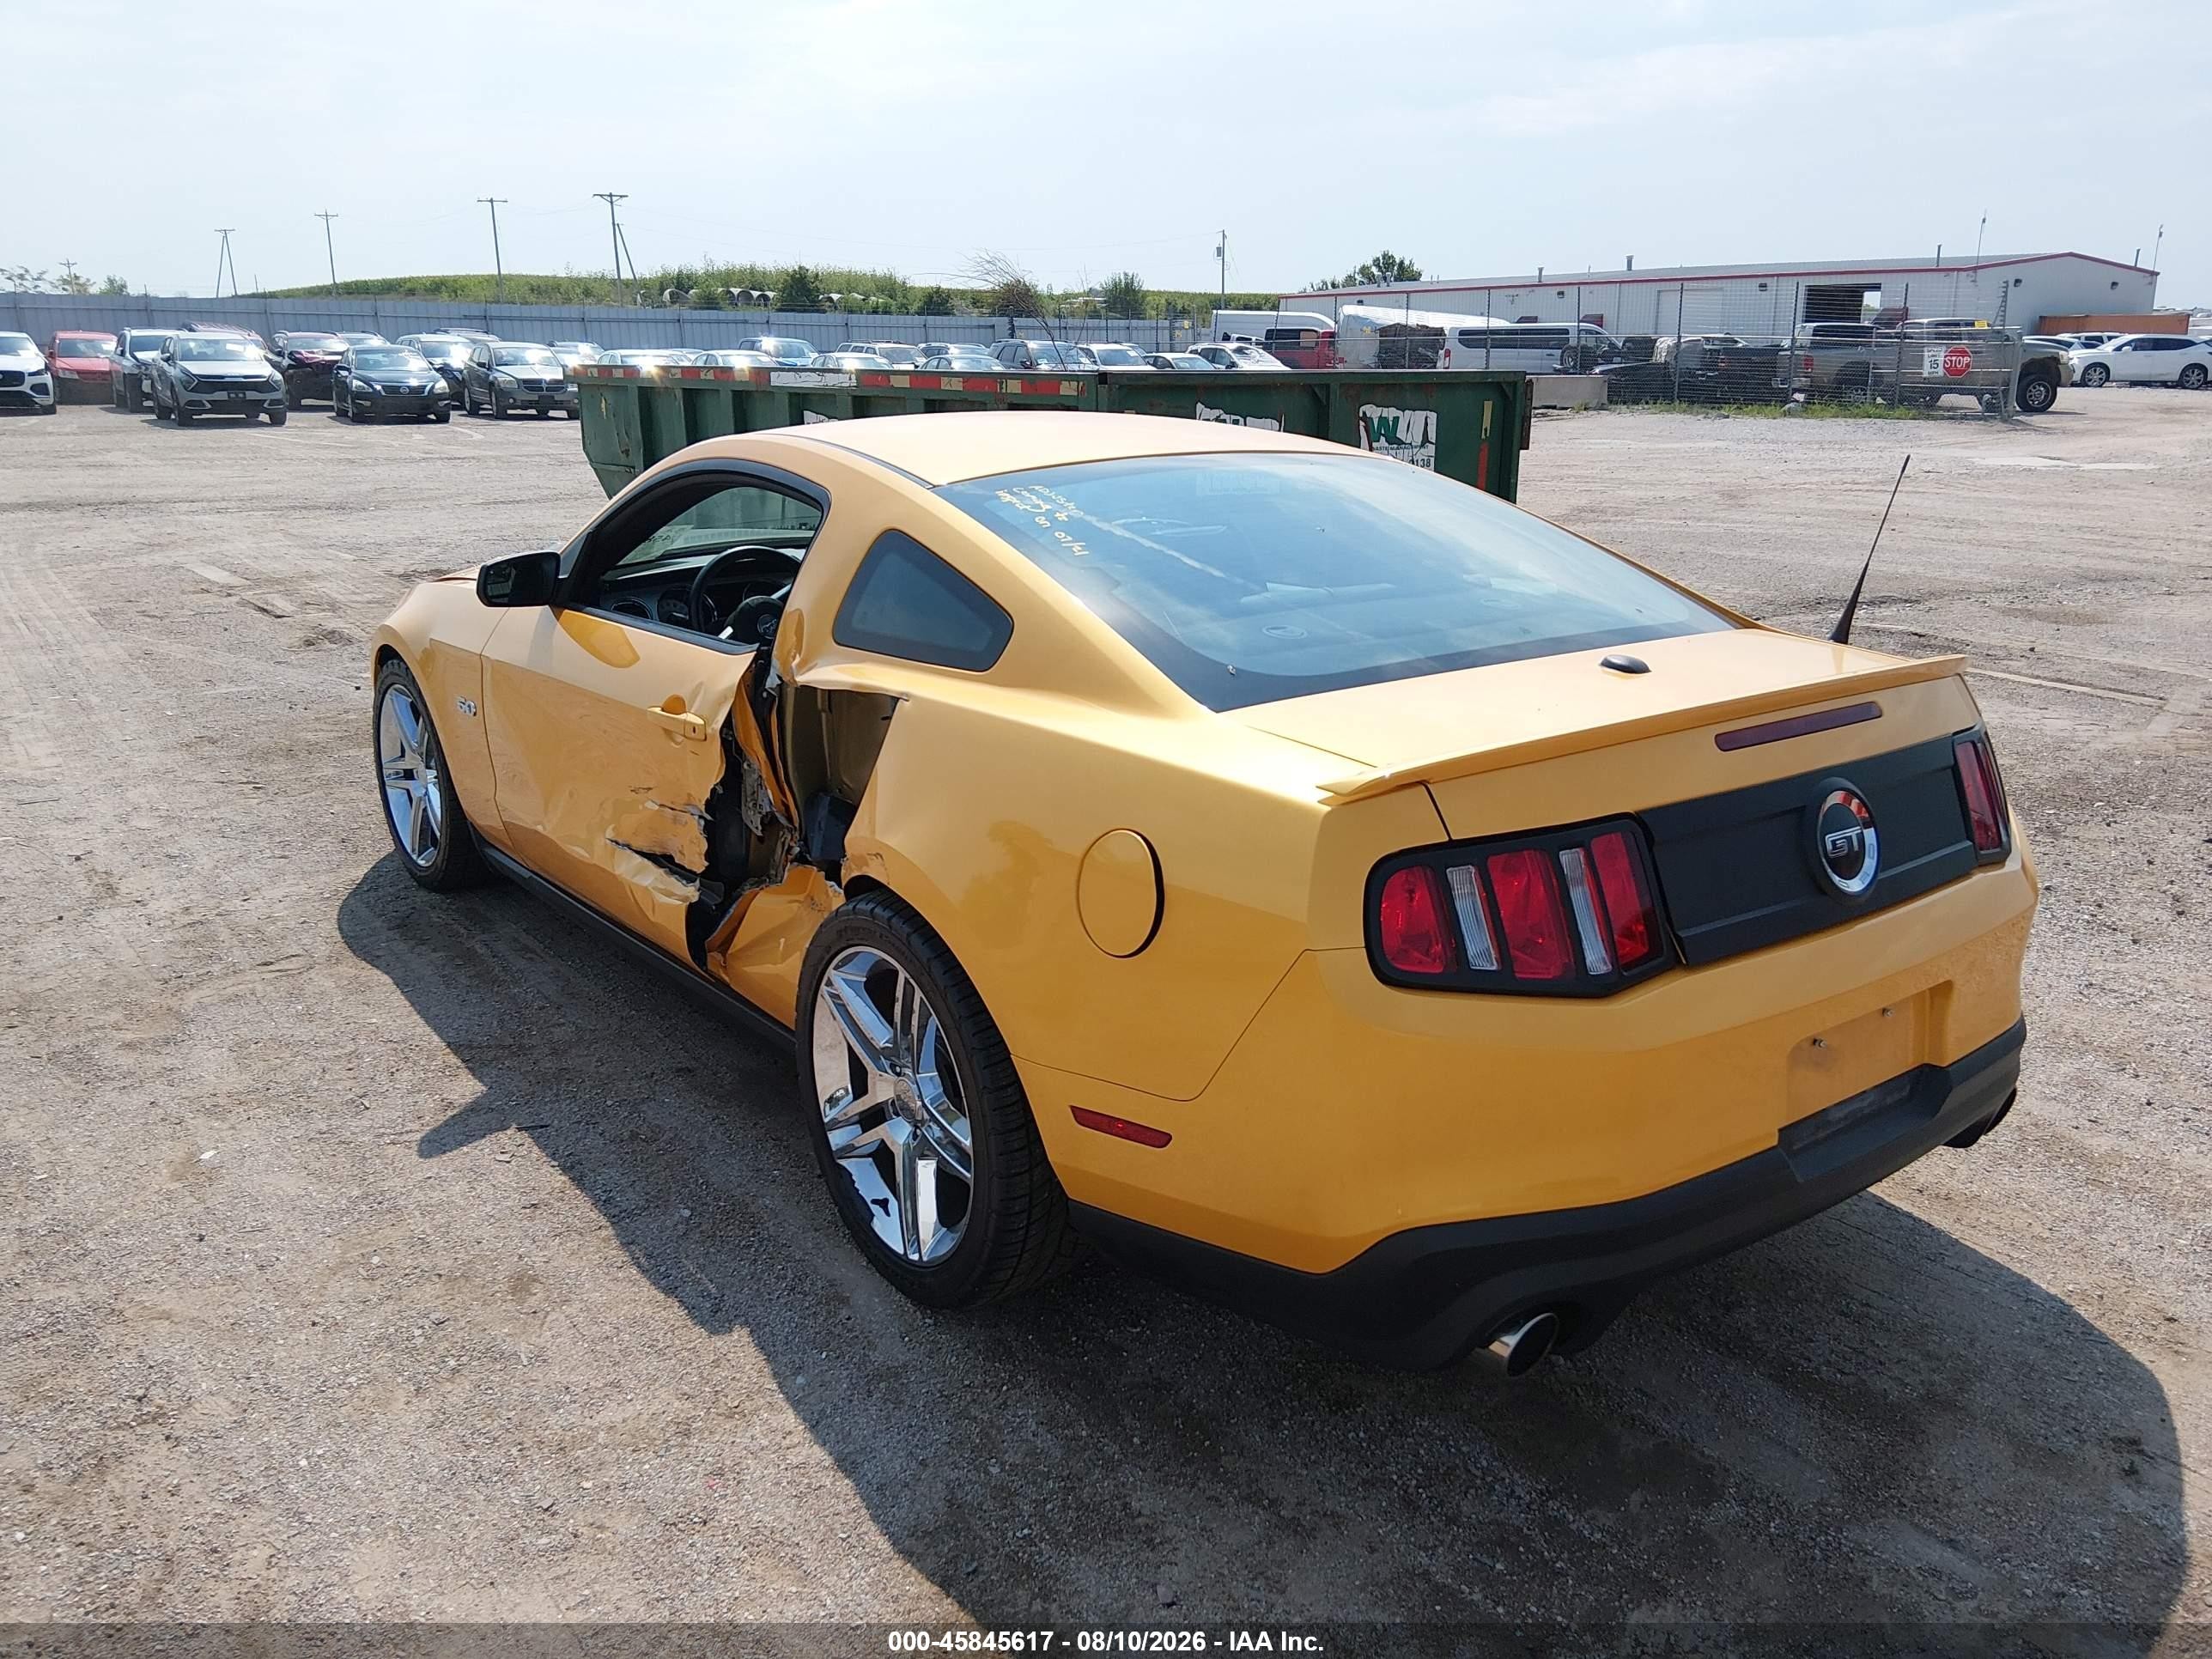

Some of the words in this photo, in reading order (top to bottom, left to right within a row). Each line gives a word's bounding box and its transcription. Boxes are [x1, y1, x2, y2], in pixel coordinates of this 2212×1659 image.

[1929, 359, 1940, 370] 15
[1944, 356, 1972, 368] STOP
[1825, 825, 1863, 859] GT
